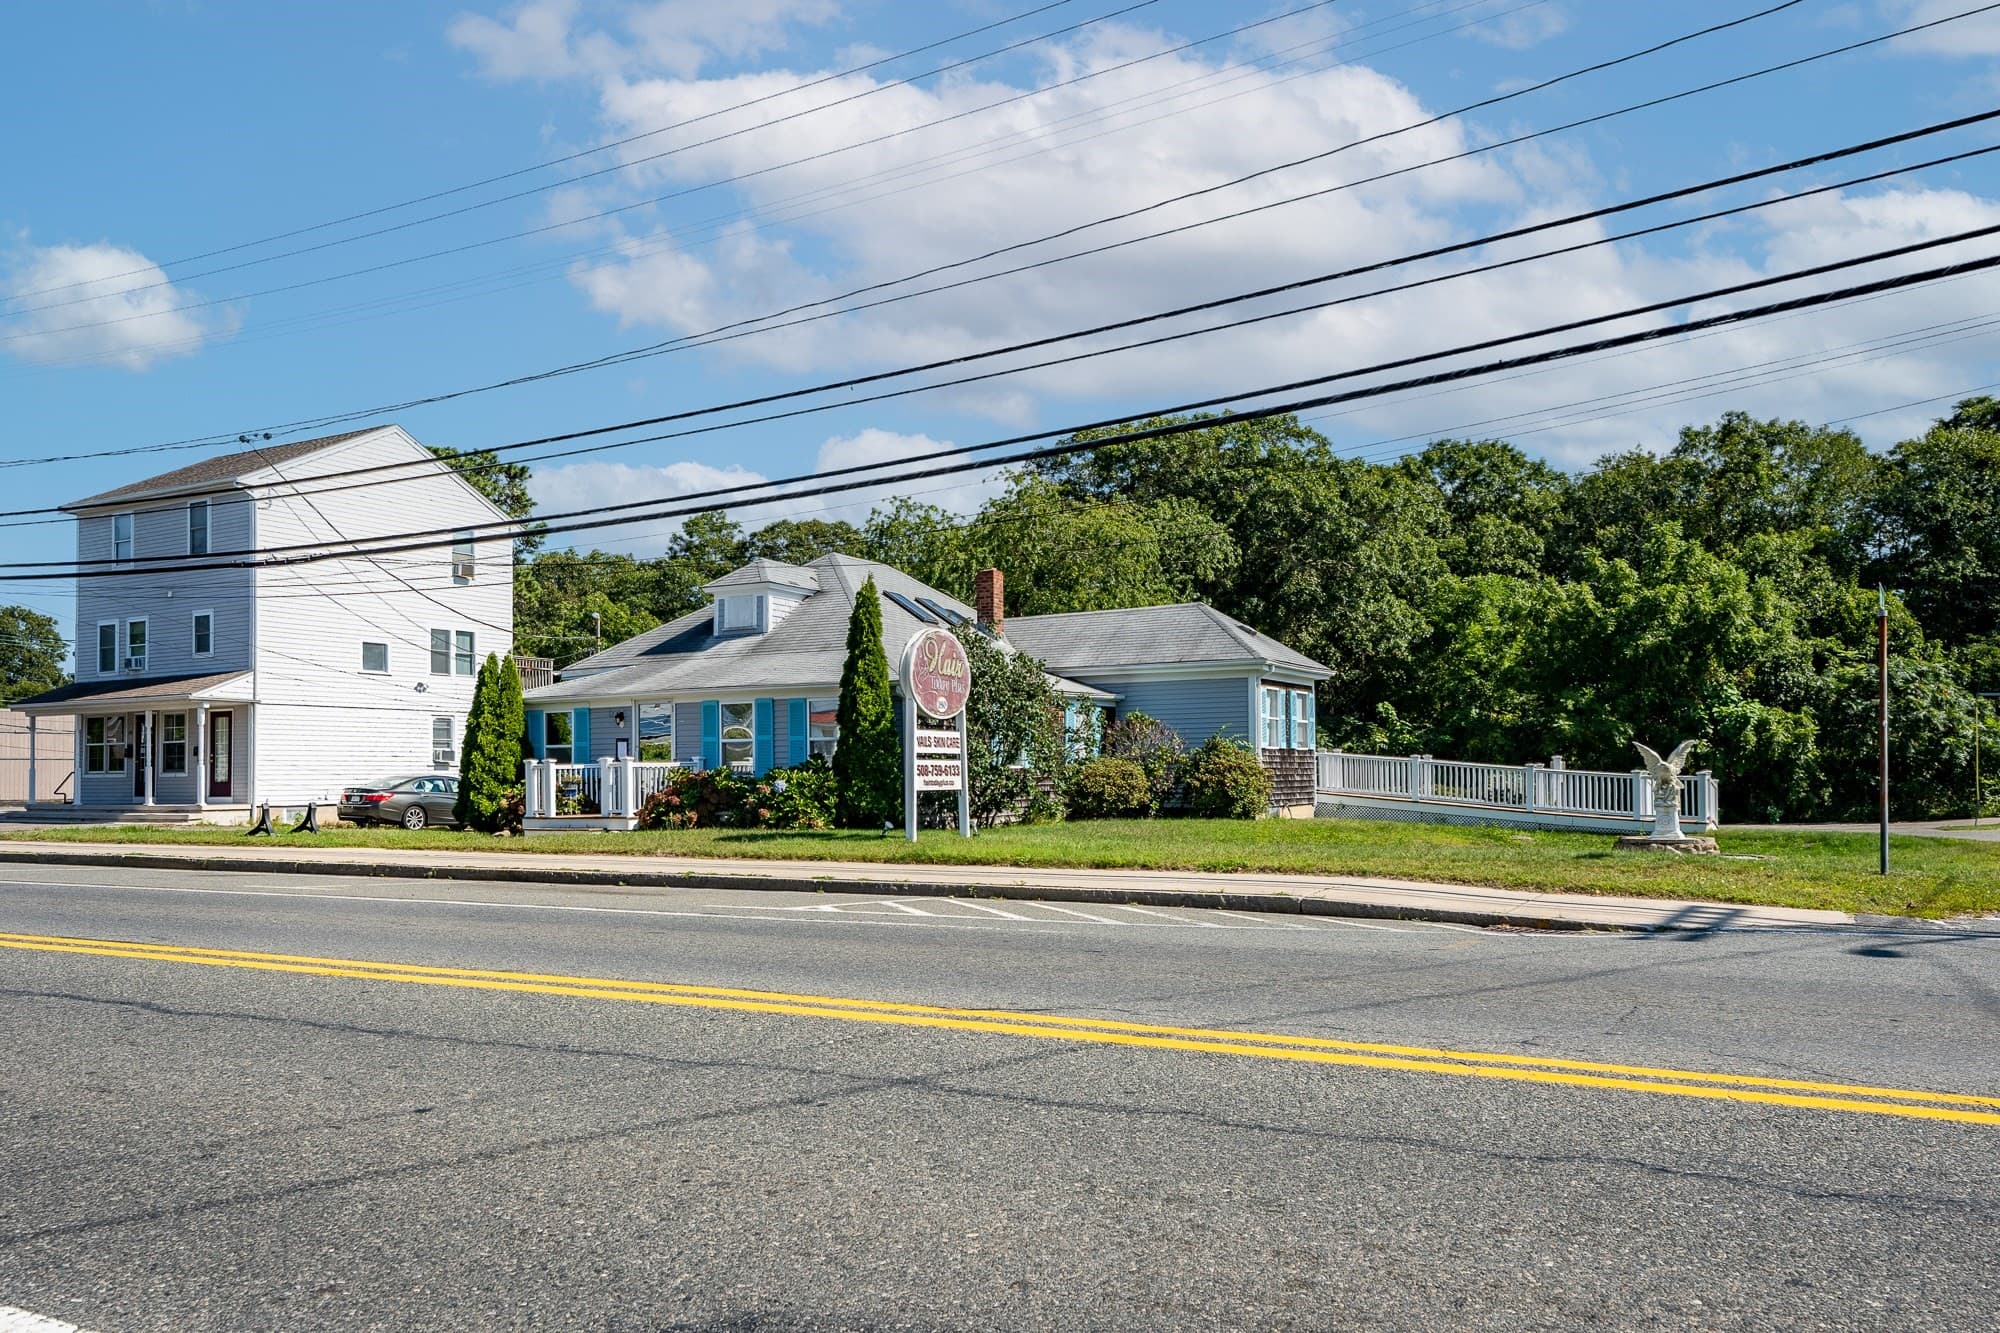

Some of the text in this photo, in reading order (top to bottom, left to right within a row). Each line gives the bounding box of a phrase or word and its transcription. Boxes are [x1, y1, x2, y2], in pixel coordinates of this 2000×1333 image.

[925, 637, 965, 678] Hair
[929, 675, 966, 696] Today Plus
[933, 736, 946, 748] SKIN
[946, 736, 960, 749] CARE
[916, 764, 960, 777] 508-759-6133
